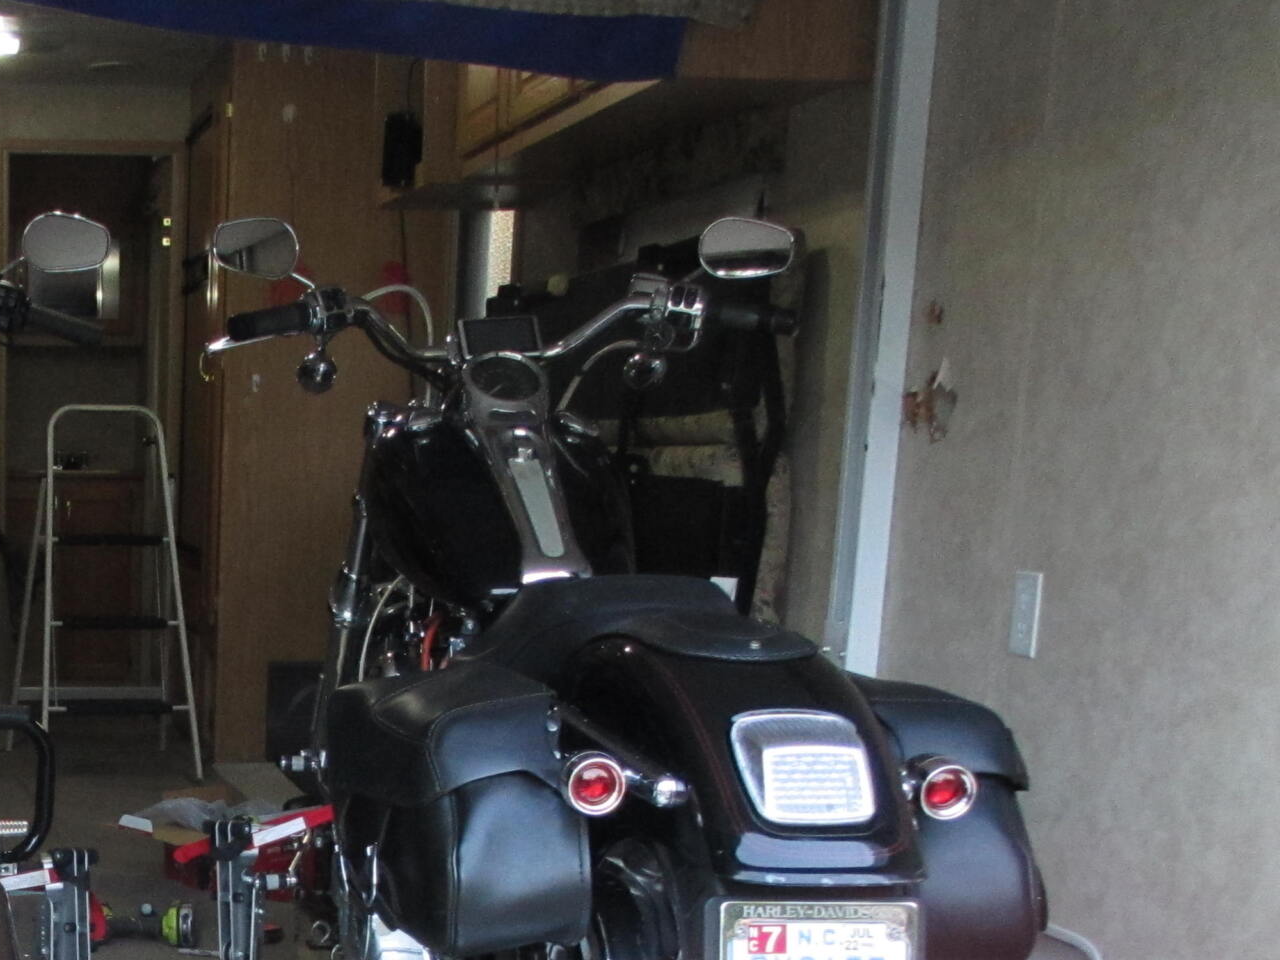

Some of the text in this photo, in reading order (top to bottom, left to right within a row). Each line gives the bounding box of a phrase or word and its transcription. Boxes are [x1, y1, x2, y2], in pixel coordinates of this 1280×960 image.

[742, 905, 892, 919] HARLEY-DAVIDS
[761, 925, 783, 953] 7
[850, 927, 874, 939] JUL
